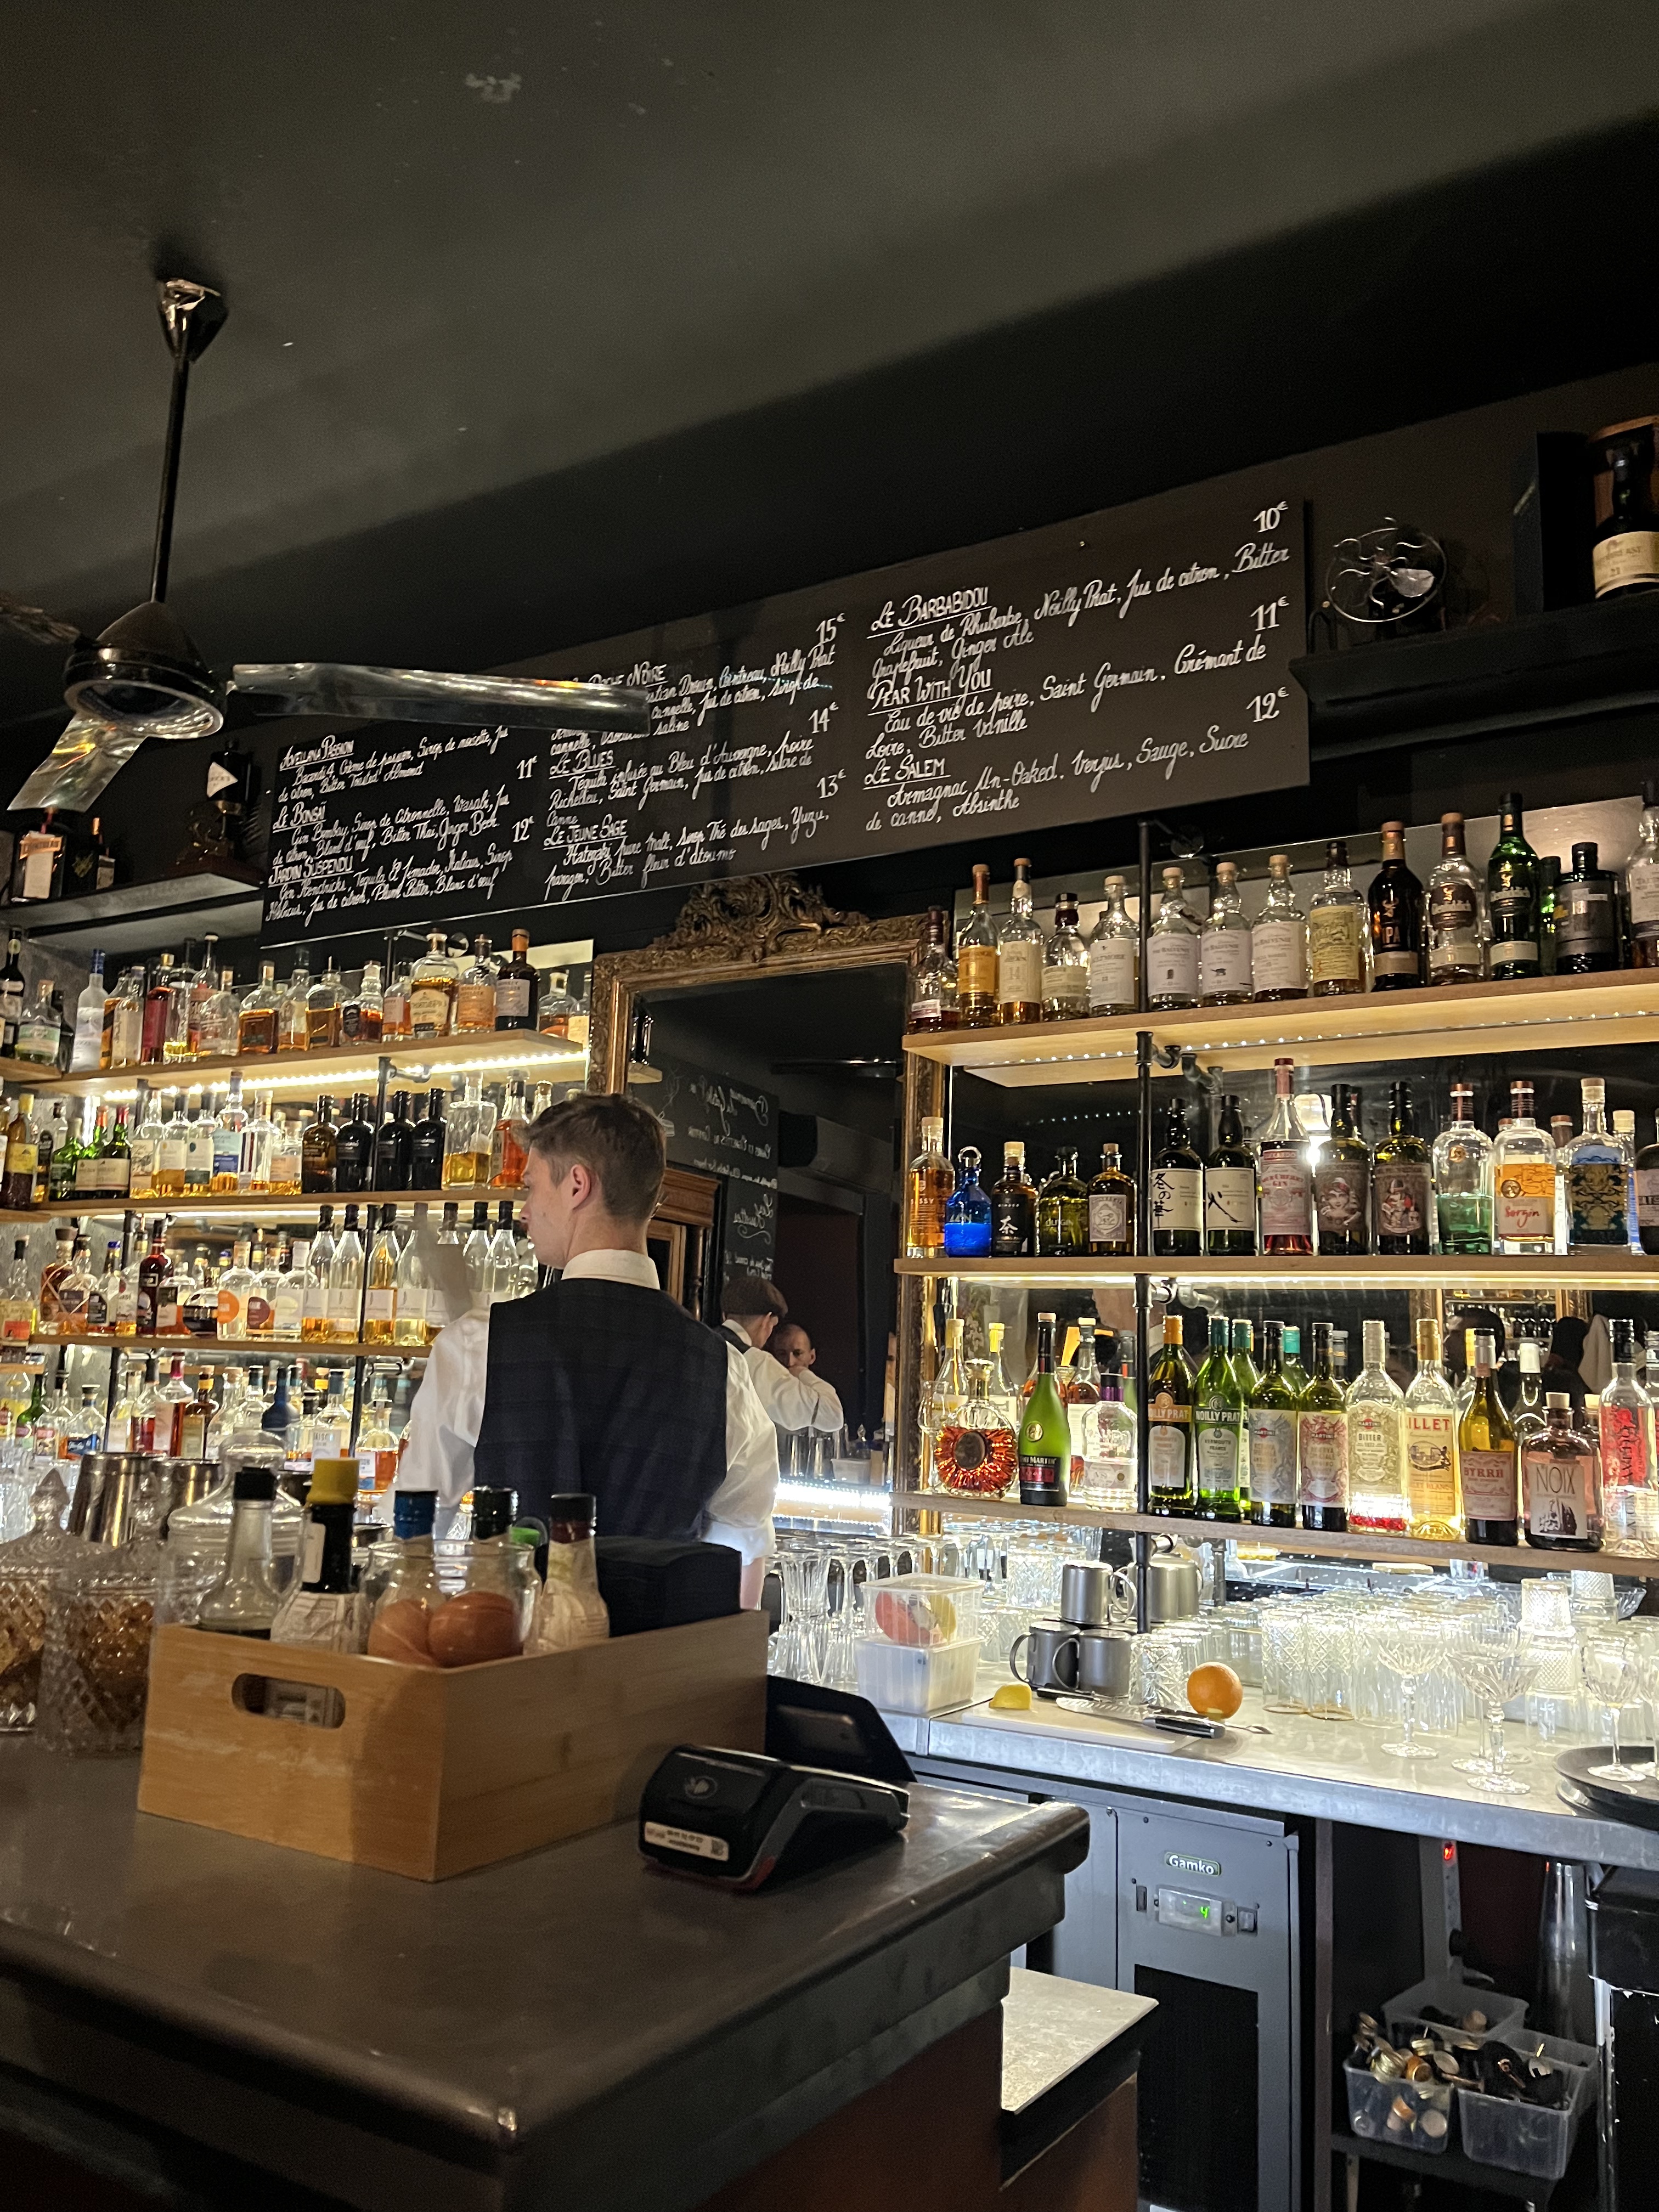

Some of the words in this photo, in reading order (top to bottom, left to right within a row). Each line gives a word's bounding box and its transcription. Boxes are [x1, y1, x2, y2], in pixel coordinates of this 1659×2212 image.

[940, 624, 954, 642] de
[1034, 586, 1081, 627] Noilly
[1156, 567, 1175, 592] de
[1231, 542, 1289, 573] Bitter
[871, 601, 895, 631] LE
[898, 587, 988, 627] BARBABIDOU
[950, 637, 997, 680] Ginger
[1003, 618, 1034, 648] Ale
[720, 691, 732, 707] de
[803, 673, 819, 690] de
[872, 679, 910, 709] PEAR
[953, 665, 991, 713] YOU
[884, 709, 911, 733] Eau
[916, 705, 935, 727] de
[965, 696, 984, 716] de
[1040, 673, 1087, 701] Saint
[1174, 640, 1244, 674] Crémant
[1245, 634, 1267, 662] de
[918, 723, 966, 748] Bitter
[973, 709, 1028, 737] Vanille
[365, 751, 377, 769] de
[445, 737, 455, 752] de
[550, 752, 571, 775] LE
[572, 749, 613, 772] BLUES
[668, 751, 695, 773] Bleu
[608, 781, 637, 800] Saint
[714, 766, 726, 781] de
[799, 753, 812, 766] de
[864, 758, 890, 785] LE
[894, 753, 945, 780] SALEM
[887, 781, 967, 816] Armagnac
[1136, 737, 1194, 780] Sauge,
[1199, 725, 1249, 754] Sucre
[278, 787, 288, 803] de
[319, 775, 346, 793] Bitter
[273, 805, 289, 830] LE
[380, 813, 391, 827] de
[866, 811, 882, 831] de
[952, 789, 1019, 817] Absinthe
[544, 826, 565, 846] LE
[567, 825, 599, 843] JEUNE
[600, 814, 628, 838] SAGE
[707, 819, 727, 841] Thé
[791, 806, 828, 844] Yuzu,
[273, 849, 283, 866] de
[380, 826, 411, 845] Bitter
[303, 855, 353, 878] SUSPENDU
[595, 857, 634, 885] Bitter
[327, 894, 338, 909] de
[432, 874, 465, 894] Blanc
[1504, 1206, 1541, 1228] Sorgin
[1148, 1407, 1166, 1418] OILLY
[1167, 1409, 1188, 1419] PRAT
[1196, 1410, 1220, 1421] NOILLY
[1222, 1411, 1240, 1422] PRAT
[1407, 1417, 1450, 1431] ILLET
[1358, 1433, 1381, 1442] BITTER
[1029, 1455, 1054, 1465] MARTIN
[1464, 1466, 1504, 1479] BYRRH
[1536, 1466, 1576, 1495] NOIX
[1169, 1855, 1215, 1875] Gamko
[1200, 1906, 1209, 1918] 4
